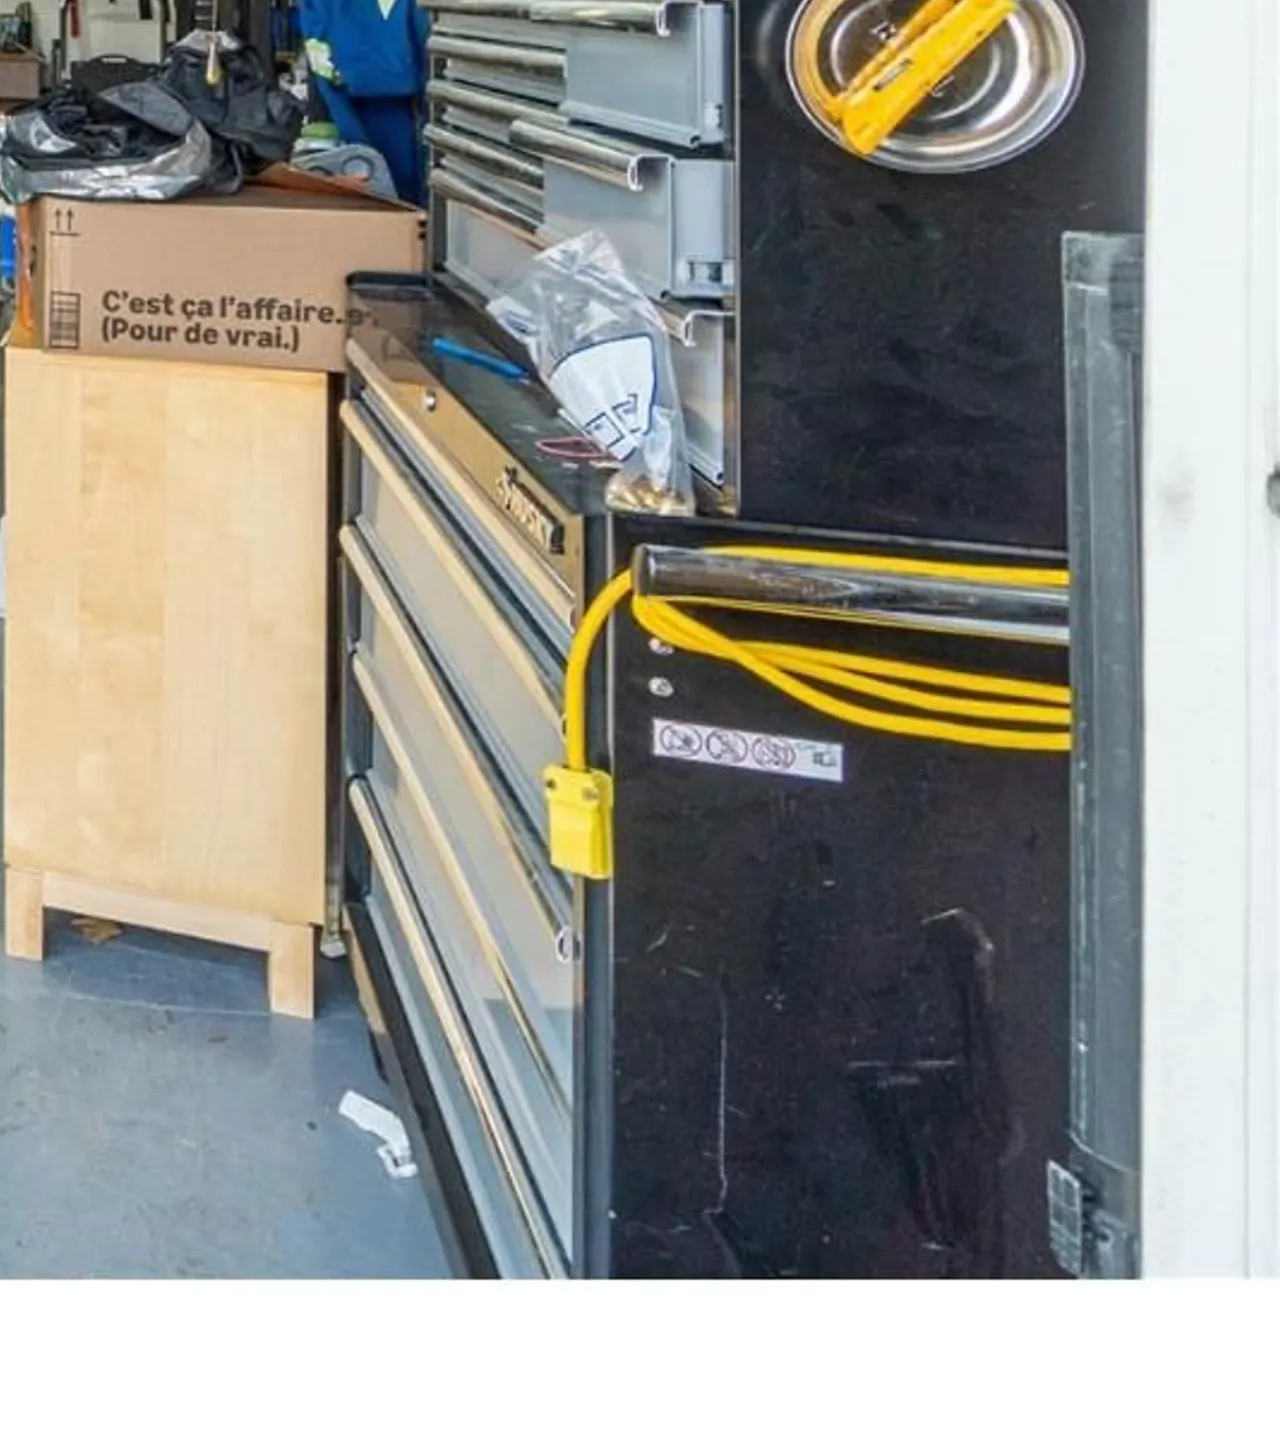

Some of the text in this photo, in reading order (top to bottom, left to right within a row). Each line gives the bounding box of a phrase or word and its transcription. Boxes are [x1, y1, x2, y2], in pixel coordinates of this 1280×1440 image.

[102, 290, 344, 325] C'est ça l'affaire.
[102, 316, 300, 353] (Pour de vrai.)
